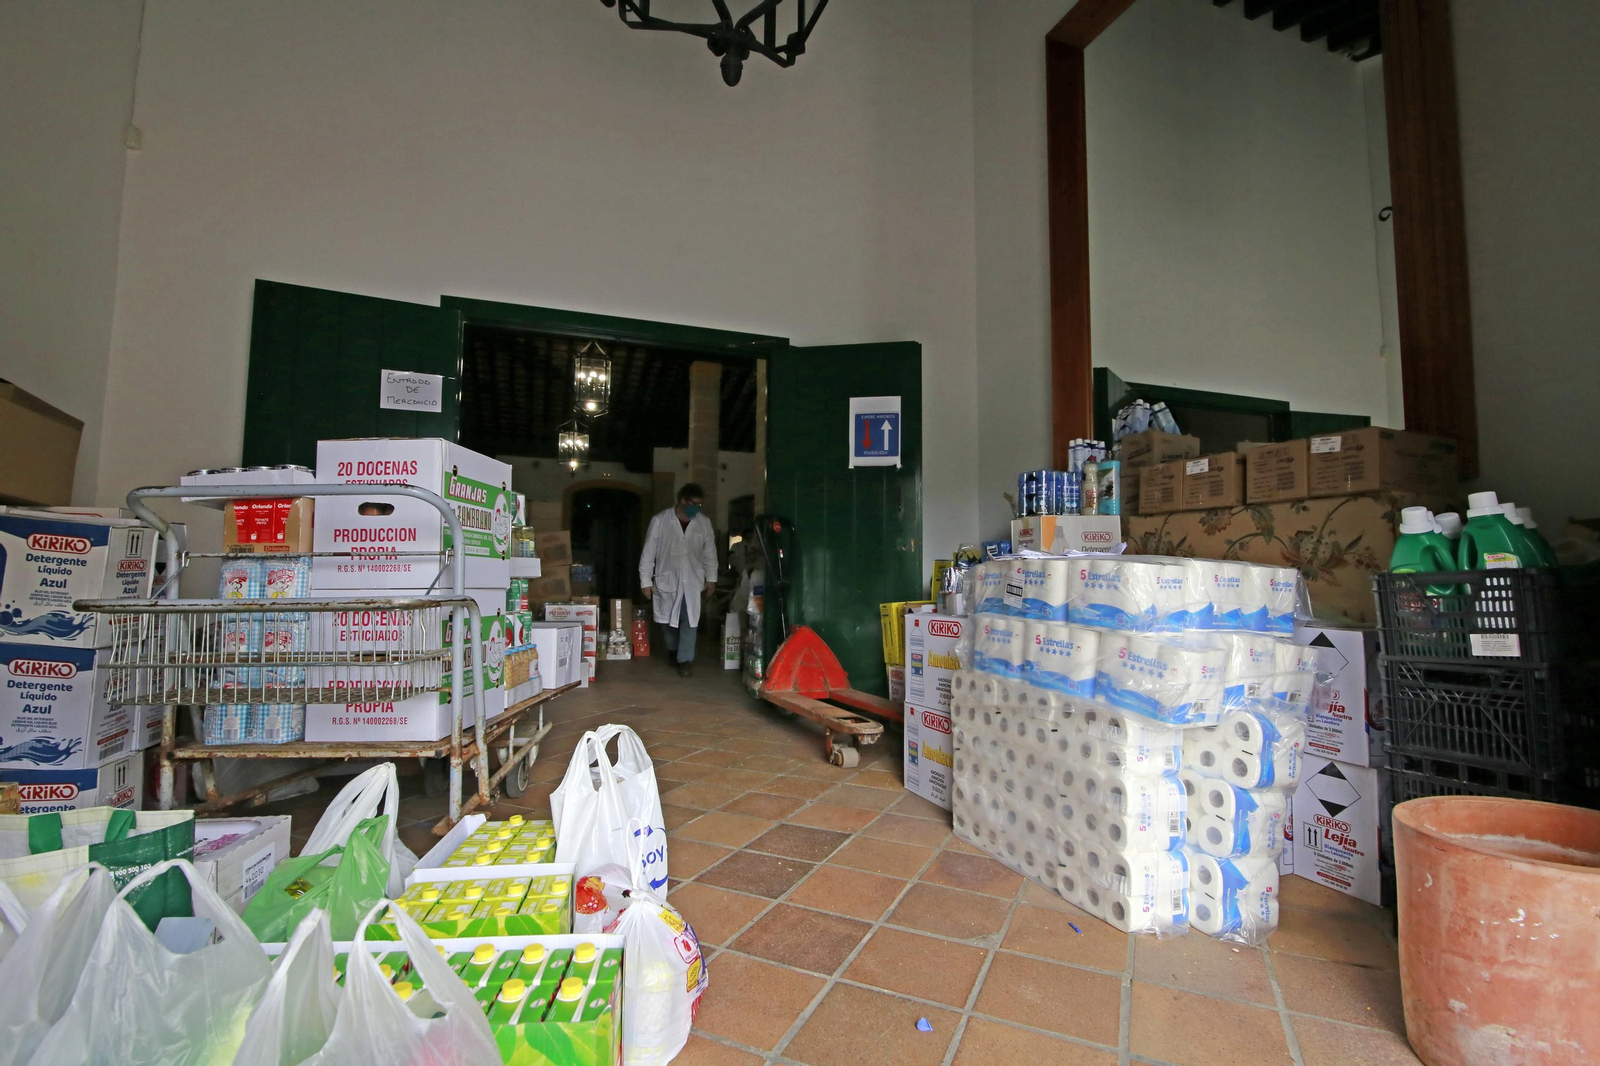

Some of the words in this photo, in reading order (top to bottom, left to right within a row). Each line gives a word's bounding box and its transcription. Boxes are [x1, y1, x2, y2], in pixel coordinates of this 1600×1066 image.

[337, 462, 353, 476] 20
[357, 460, 418, 476] DOCENAS
[448, 475, 487, 503] GRANJAS
[457, 505, 491, 531] ZAMBRANO
[334, 528, 417, 542] PRODUCCION
[350, 546, 398, 560] PROPIA
[26, 553, 88, 566] Detergente
[38, 566, 72, 575] Líquido
[116, 571, 146, 579] Detergente
[1080, 569, 1087, 581] 5
[1088, 572, 1121, 582] Estrellas
[40, 578, 67, 588] Azul
[1156, 577, 1161, 585] 5
[1214, 574, 1219, 583] 5
[1270, 579, 1274, 587] 5
[1274, 580, 1294, 588] Estrellas
[984, 625, 989, 635] 5
[990, 628, 1013, 638] Estrellas
[1035, 634, 1041, 645] 5
[1043, 637, 1074, 650] Estrellas
[1250, 648, 1254, 657] 5
[1118, 647, 1127, 659] 5
[1127, 652, 1168, 671] Estrellas
[1202, 665, 1206, 675] 5
[7, 680, 73, 692] Detergente
[20, 691, 57, 701] Líquido
[22, 704, 52, 714] Azul
[1332, 712, 1352, 721] Neutro
[20, 805, 75, 814] etergente
[1324, 828, 1356, 848] Lejía
[1342, 845, 1365, 857] Neutro
